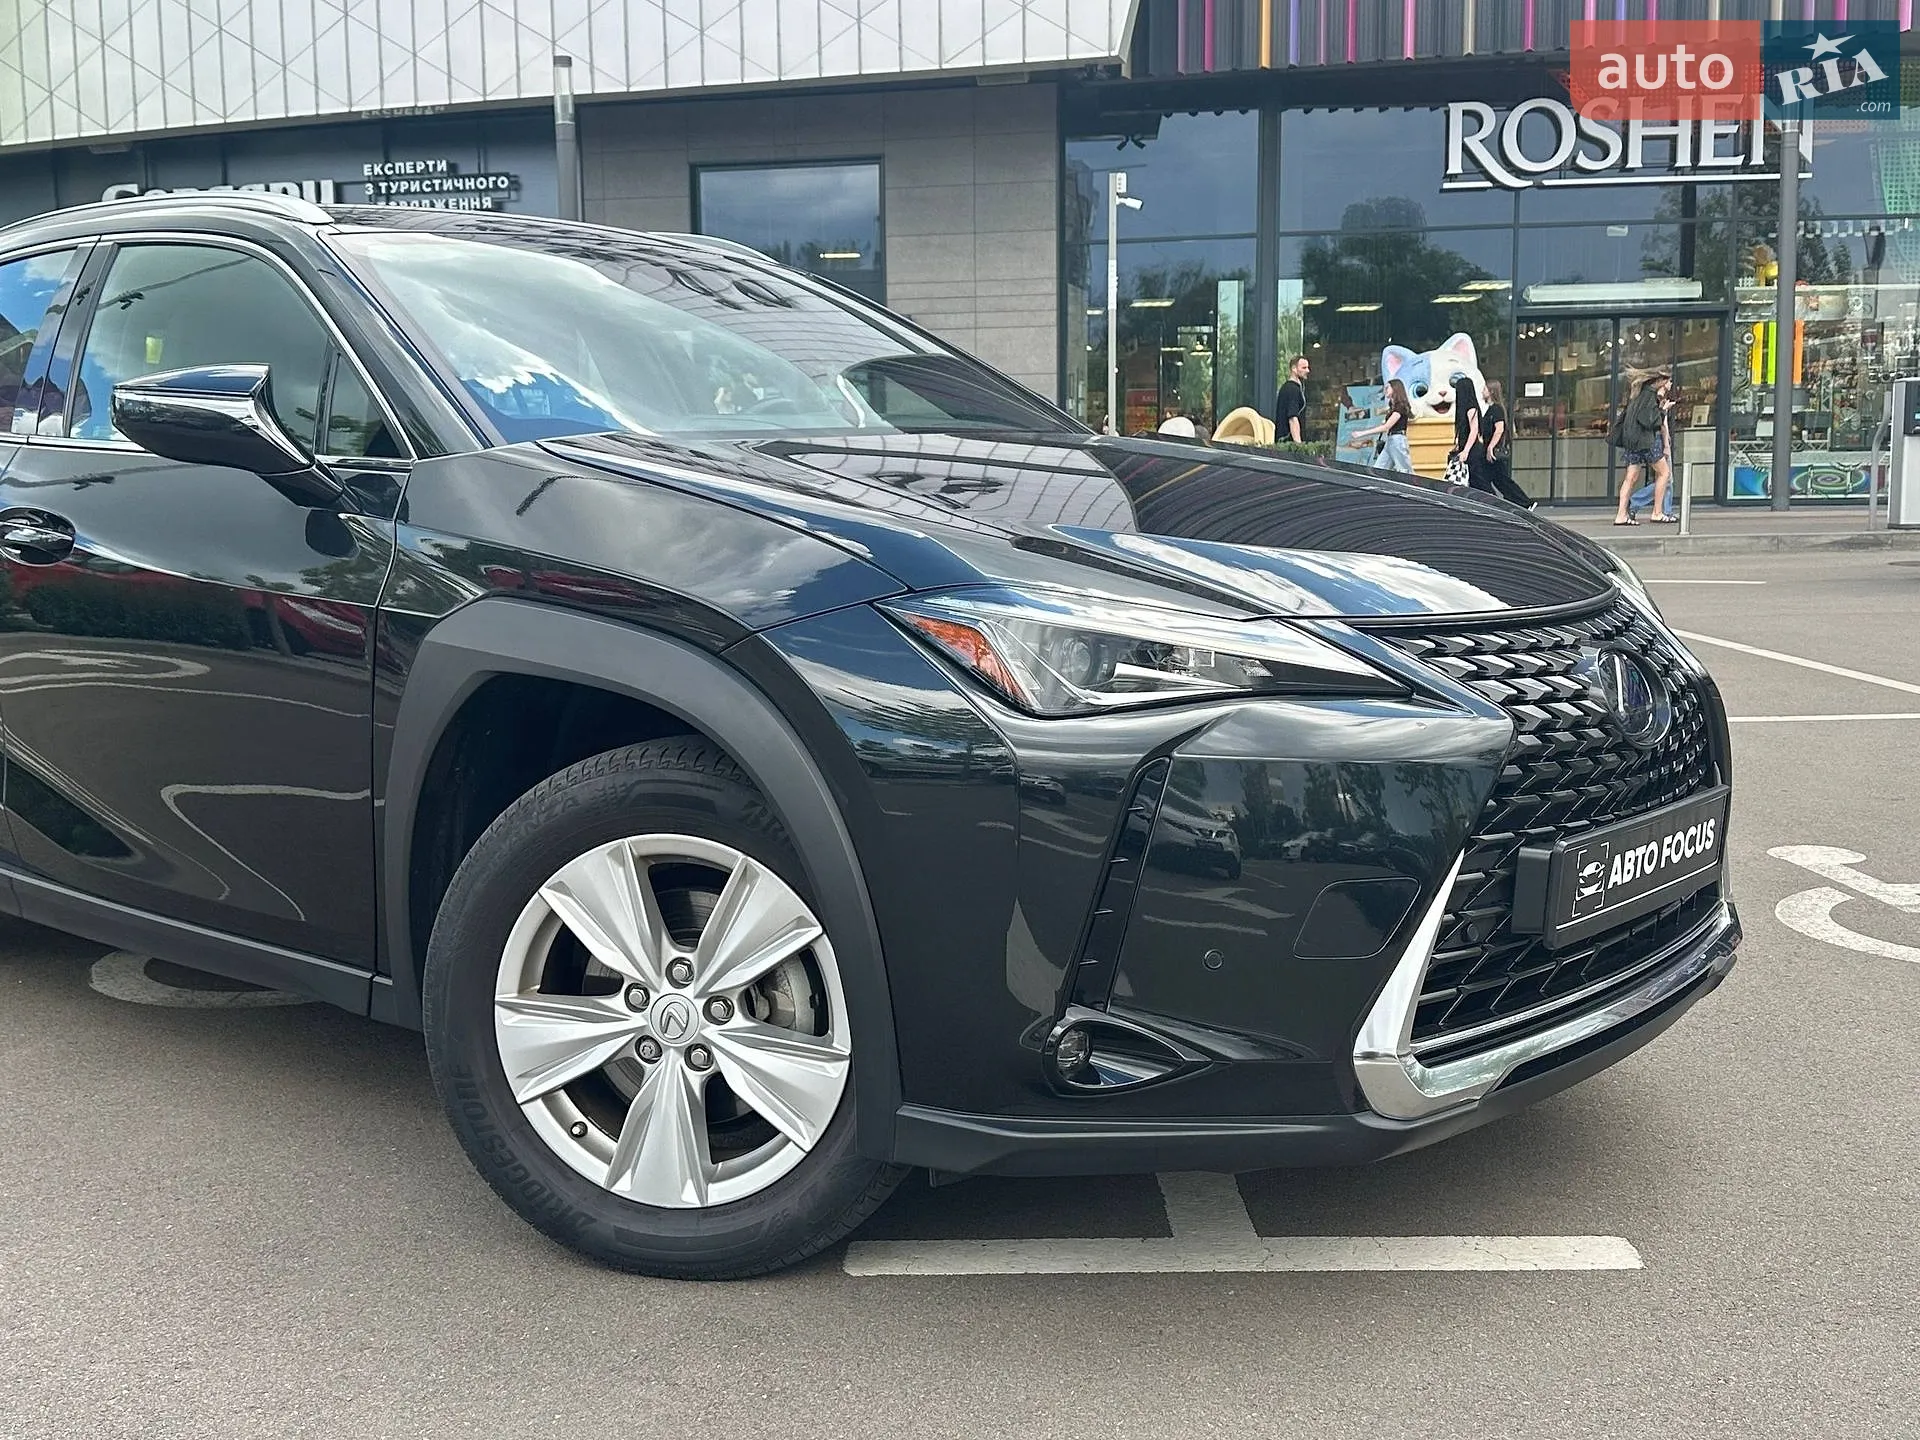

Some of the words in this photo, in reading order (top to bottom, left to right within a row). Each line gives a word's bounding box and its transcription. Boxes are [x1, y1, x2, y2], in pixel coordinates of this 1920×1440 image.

[1446, 95, 1813, 188] ROSHEN
[363, 160, 448, 176] ЕКСПЕРТИ
[365, 183, 374, 195] З
[379, 176, 509, 195] ТУРИСТИЧНОГО
[371, 197, 493, 210] РЯДЖЕННЯ
[1660, 818, 1716, 869] FOCUS
